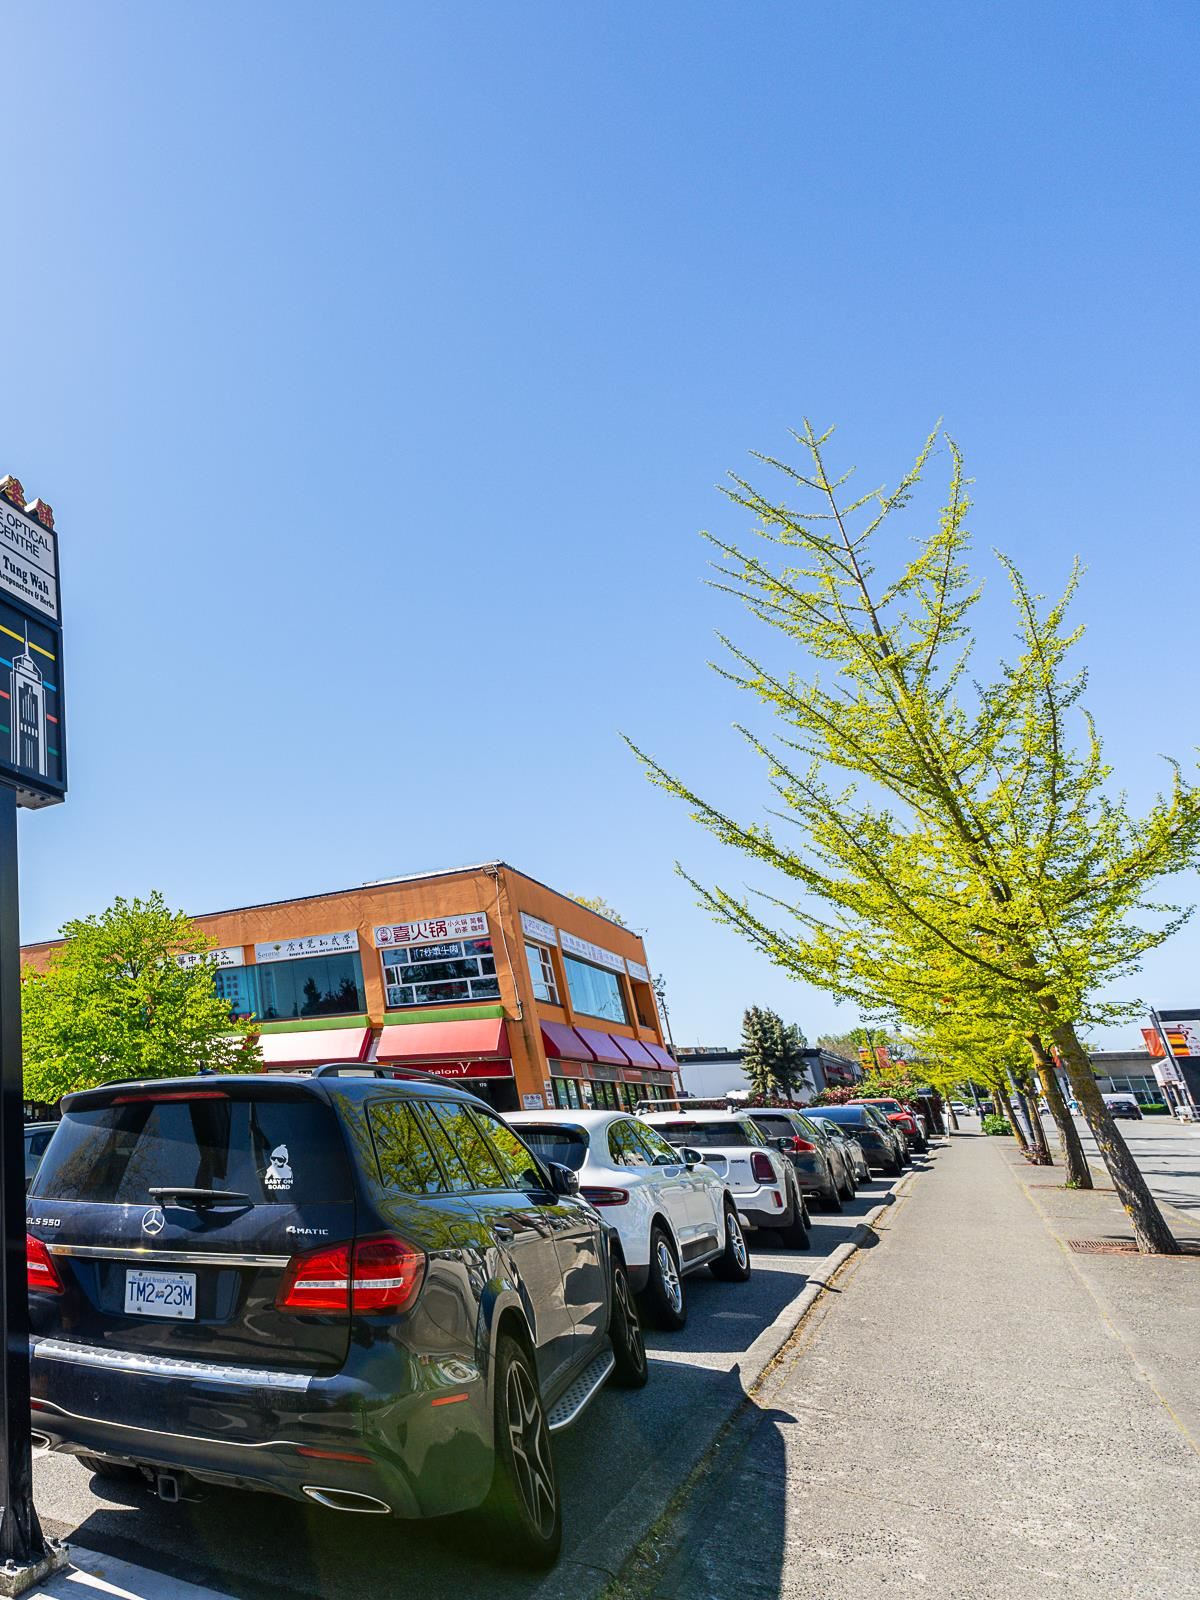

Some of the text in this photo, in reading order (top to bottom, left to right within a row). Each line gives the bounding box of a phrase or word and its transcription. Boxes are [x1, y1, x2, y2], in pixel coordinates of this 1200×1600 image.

[6, 513, 52, 553] OPTICAL
[2, 554, 50, 596] Tung Wah
[393, 920, 448, 943] 喜火锅
[457, 1062, 471, 1074] V
[25, 1216, 61, 1227] GLS 550
[285, 1225, 329, 1235] 4MATIC
[128, 1281, 193, 1306] TM2 23M
